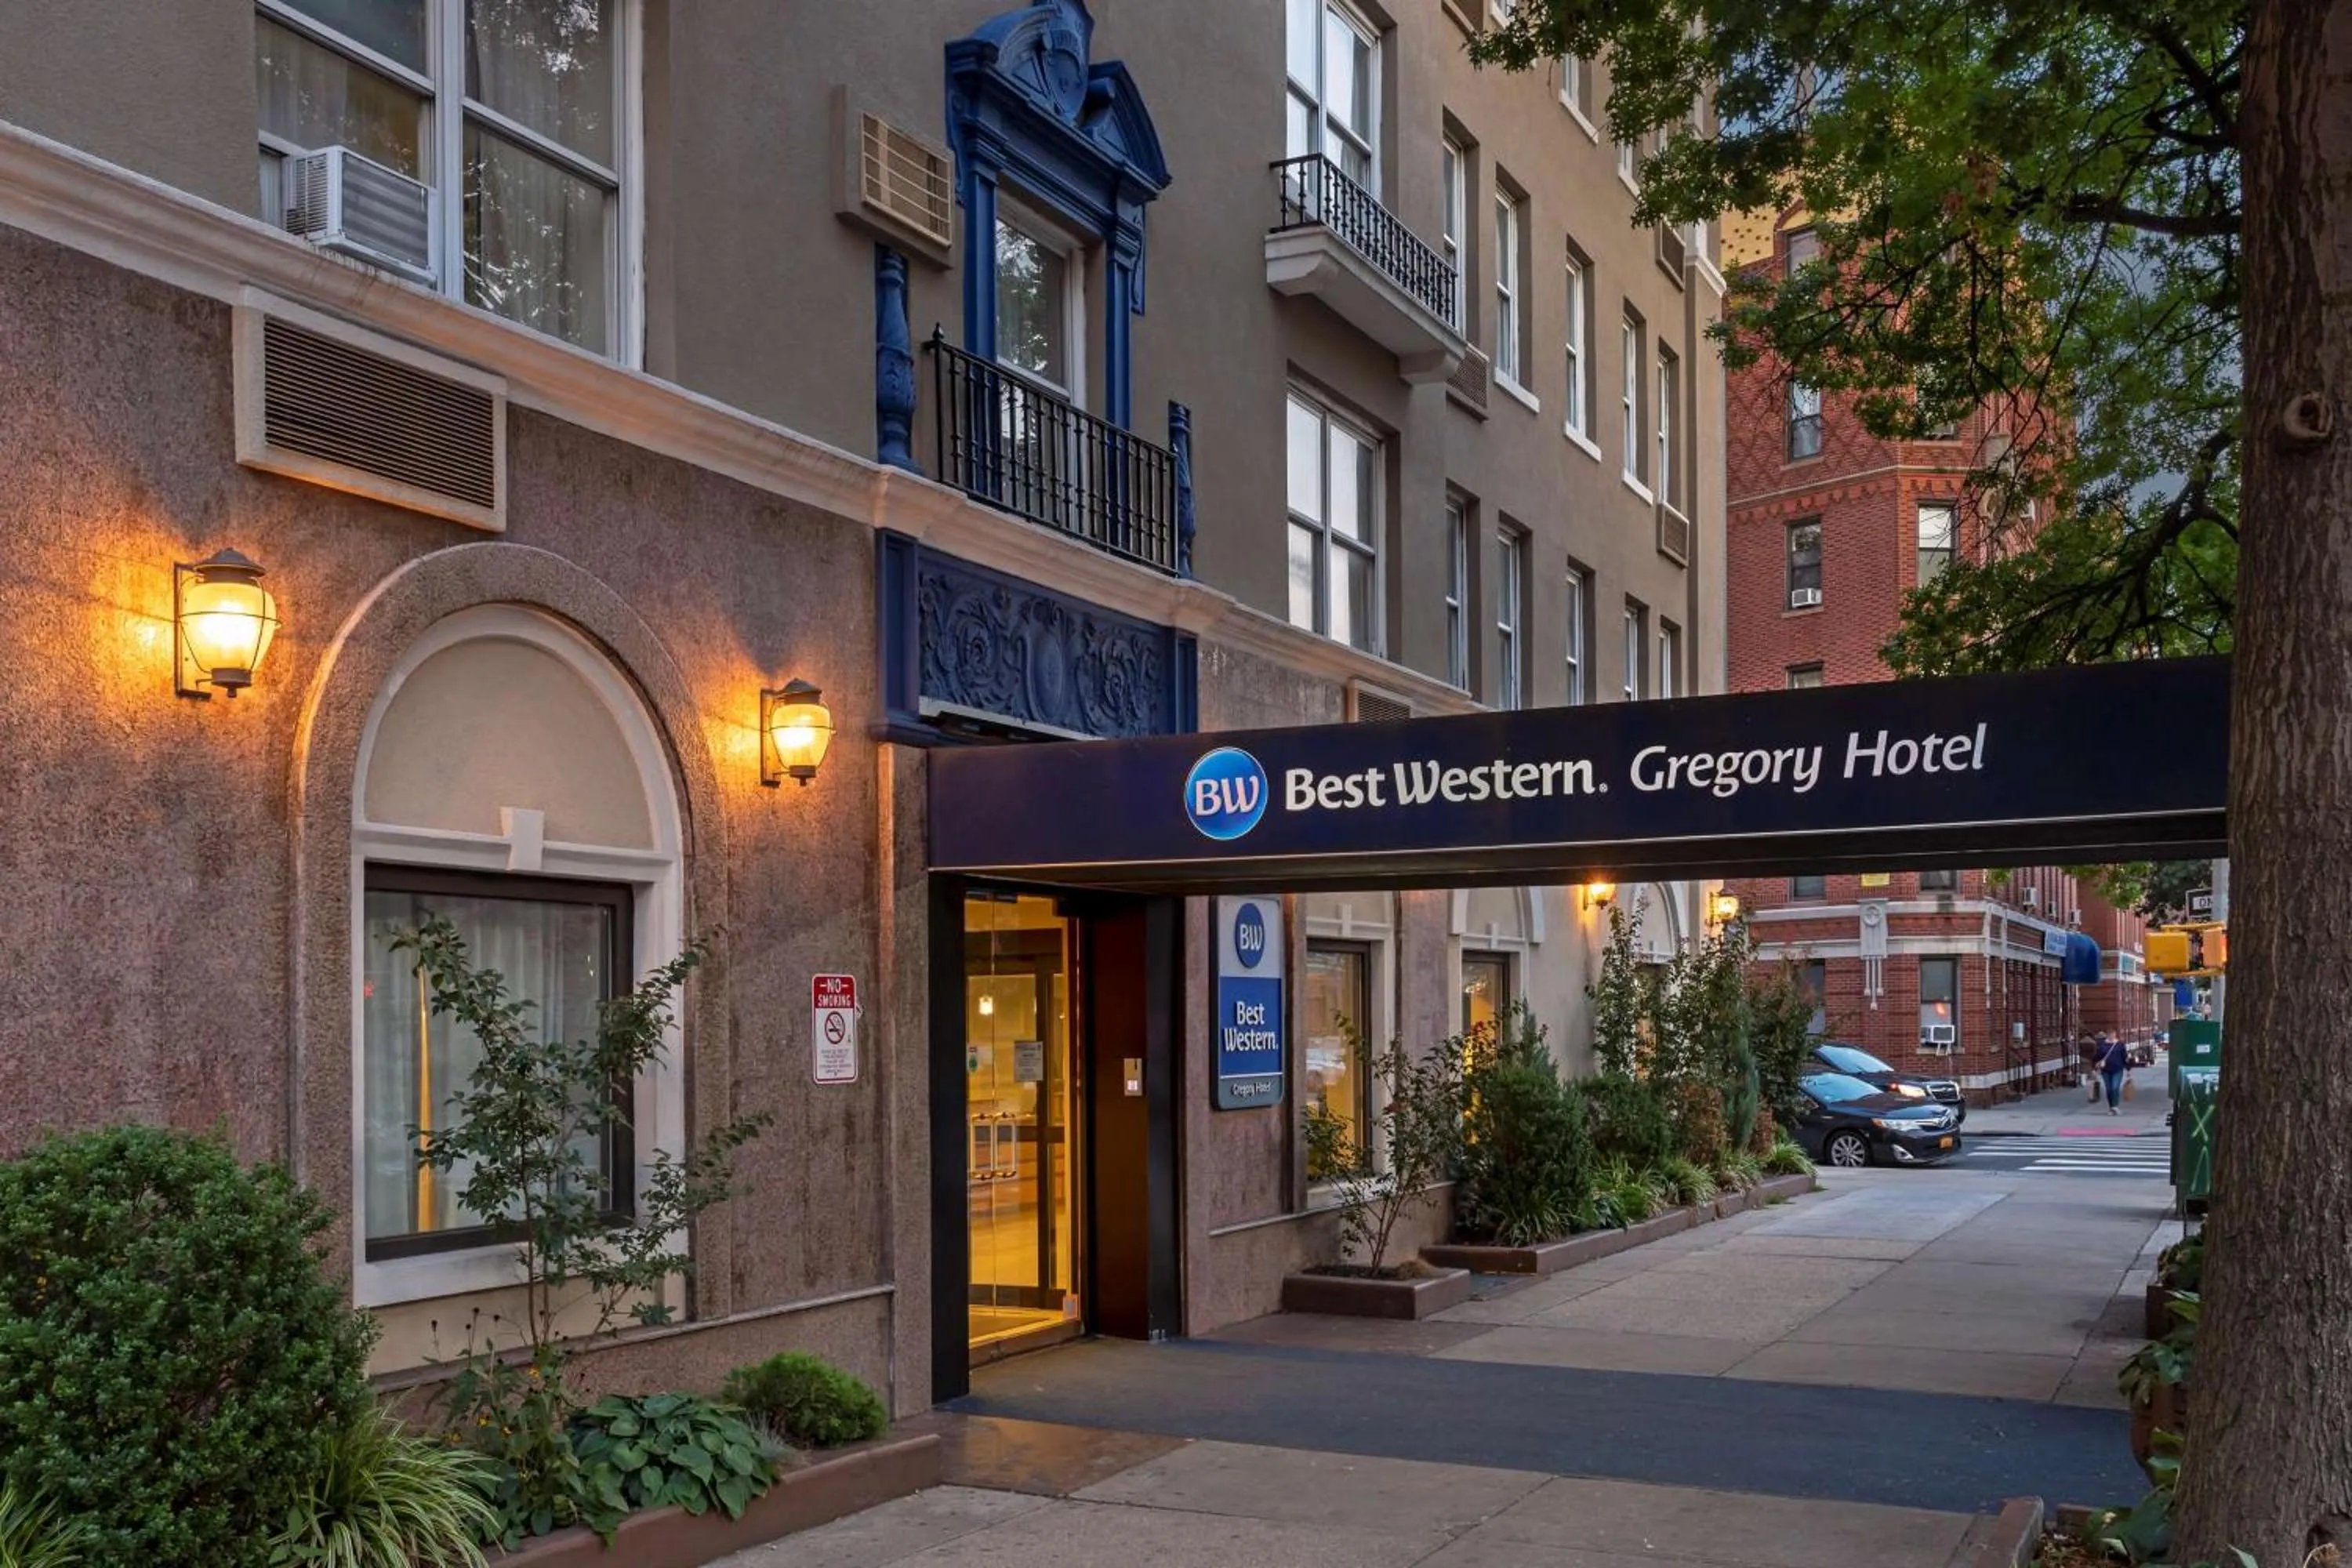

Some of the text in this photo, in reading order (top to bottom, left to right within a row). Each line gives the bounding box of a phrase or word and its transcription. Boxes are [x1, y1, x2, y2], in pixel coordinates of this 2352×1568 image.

[1285, 768, 1385, 811] Best
[1630, 745, 1823, 798] Gregory
[1843, 722, 1987, 779] Hotel
[1196, 776, 1258, 816] BW
[1240, 924, 1263, 951] BW
[827, 978, 841, 993] NO
[818, 994, 851, 1007] SMOKING
[1236, 1000, 1265, 1025] Best
